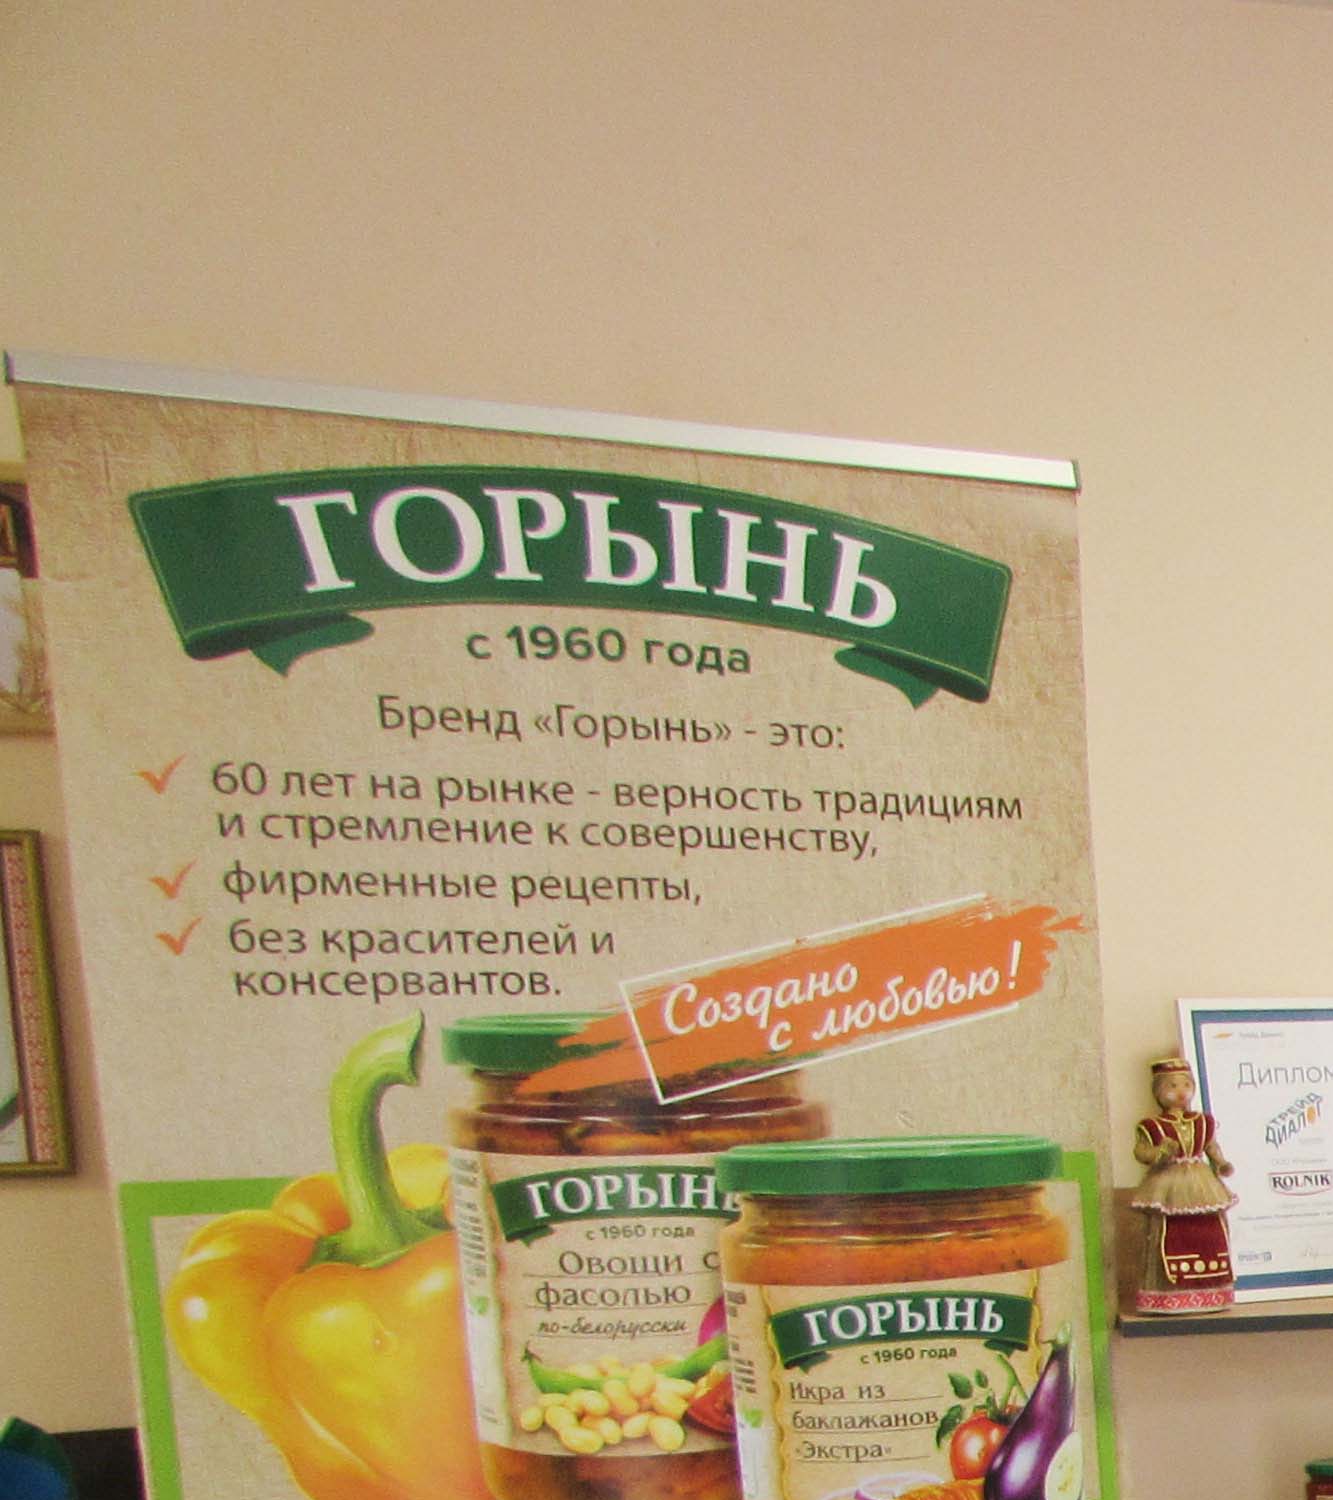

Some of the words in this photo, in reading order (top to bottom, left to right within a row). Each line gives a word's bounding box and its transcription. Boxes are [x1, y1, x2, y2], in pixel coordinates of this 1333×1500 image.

[276, 486, 897, 629] ГОРЫНЬ
[467, 631, 492, 661] с
[506, 624, 627, 663] 1960
[644, 638, 751, 675] года
[376, 695, 522, 742] Бренд
[534, 705, 732, 750] «Горынь»
[768, 719, 845, 748] это:
[212, 761, 267, 796] 60
[281, 771, 356, 798] лет
[370, 774, 421, 801] на
[437, 775, 574, 811] рынке
[614, 782, 802, 817] верность
[813, 788, 1024, 822] традициям
[218, 812, 245, 839] и
[260, 812, 533, 849] стремление
[548, 822, 568, 847] к
[580, 820, 879, 861] совершенству,
[222, 859, 498, 904] фирменные
[511, 872, 702, 907] рецепты,
[229, 917, 307, 955] без
[321, 921, 577, 964] красителей
[592, 930, 615, 956] и
[234, 968, 562, 1004] консервантов.
[664, 962, 859, 1037] Создано
[769, 1022, 793, 1053] с
[1271, 1173, 1331, 1192] ROLNIK
[586, 1227, 595, 1241] с
[600, 1225, 646, 1240] 1960
[651, 1225, 695, 1239] года
[559, 1250, 684, 1277] Овощи
[535, 1281, 692, 1312] фасолью
[538, 1316, 688, 1340] по-белорусски
[803, 1297, 1004, 1347] ГОРЫНЬ
[860, 1352, 869, 1364] с
[874, 1347, 915, 1363] 1960
[920, 1346, 957, 1360] года
[790, 1381, 845, 1404] Икра
[858, 1384, 886, 1400] из
[792, 1409, 939, 1430] баклажанов
